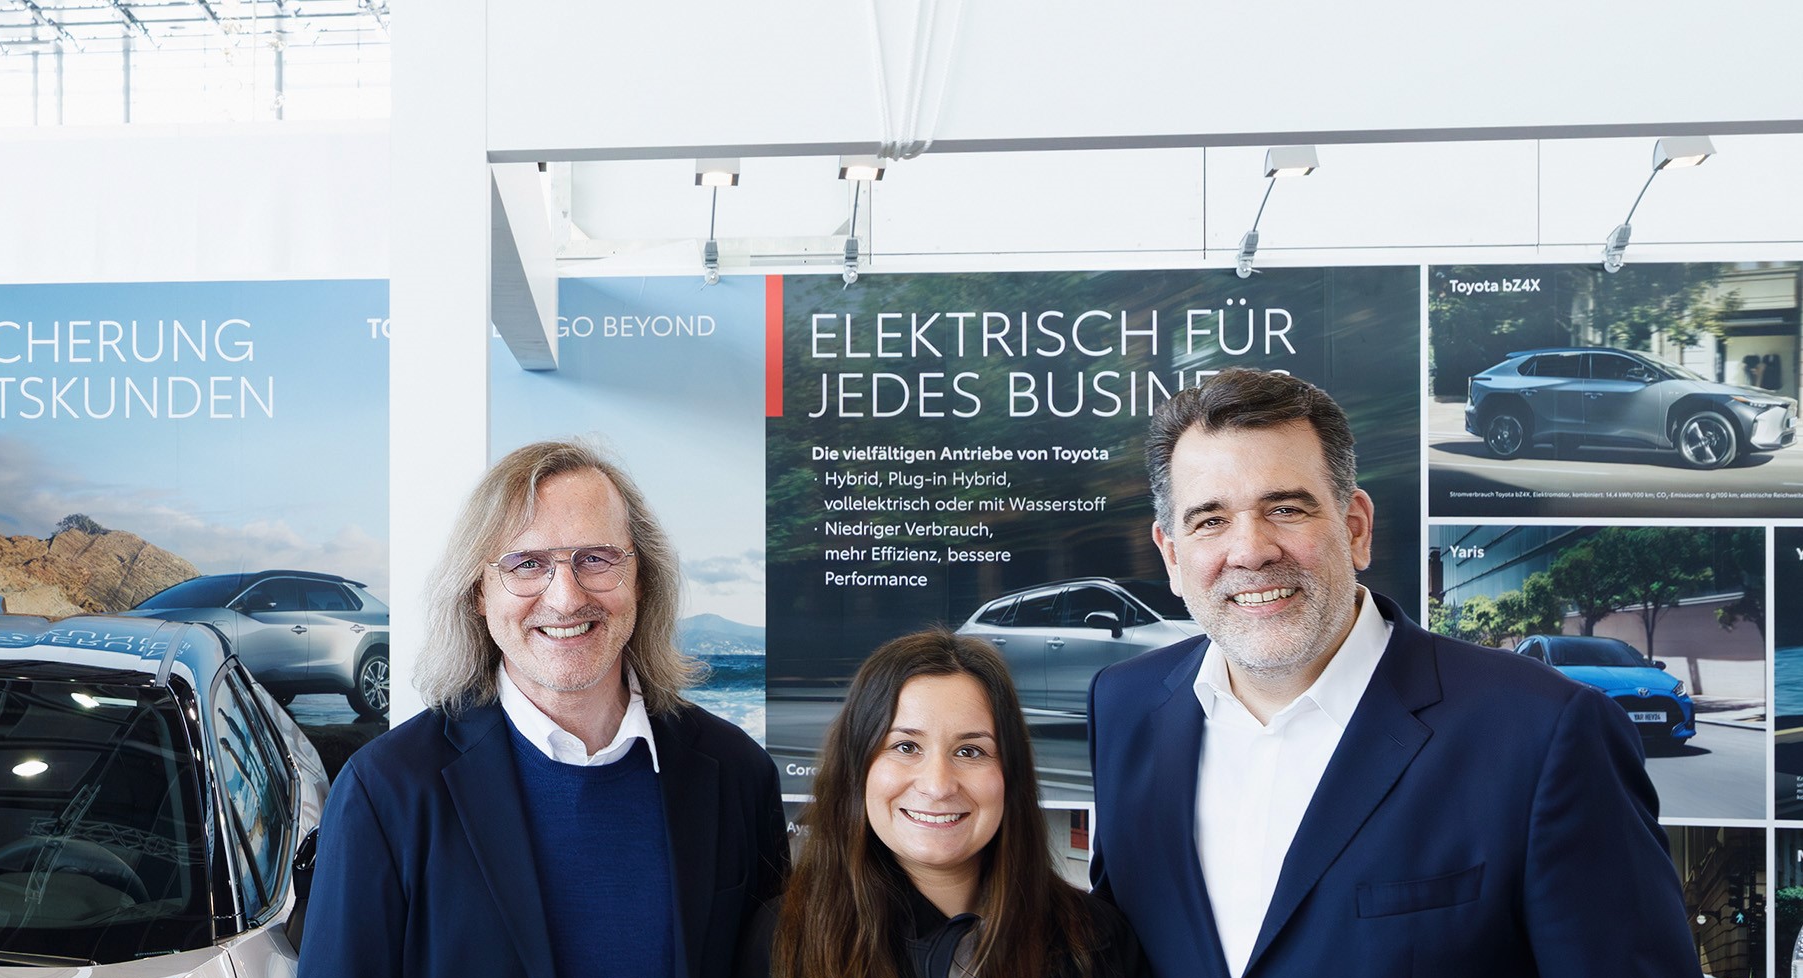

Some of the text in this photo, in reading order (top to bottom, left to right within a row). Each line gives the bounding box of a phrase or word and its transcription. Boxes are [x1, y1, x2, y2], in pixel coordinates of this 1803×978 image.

[1450, 279, 1540, 293] Toyota bZ4X
[604, 315, 715, 337] BEYOND
[811, 297, 1297, 358] ELEKTRISCH FÜR
[808, 371, 982, 418] JEDES
[812, 446, 1109, 463] Die vielfältigen Antriebe von Toyota
[825, 472, 1011, 489] Hybrid, Plug-in Hybrid,
[824, 496, 1107, 512] vollelektrisch oder mit Wasserstoff
[825, 521, 994, 539] Niedriger Verbrauch,
[825, 546, 1011, 564] mehr Effizienz, bessere
[1450, 545, 1485, 559] Yaris
[825, 571, 928, 587] Performance
